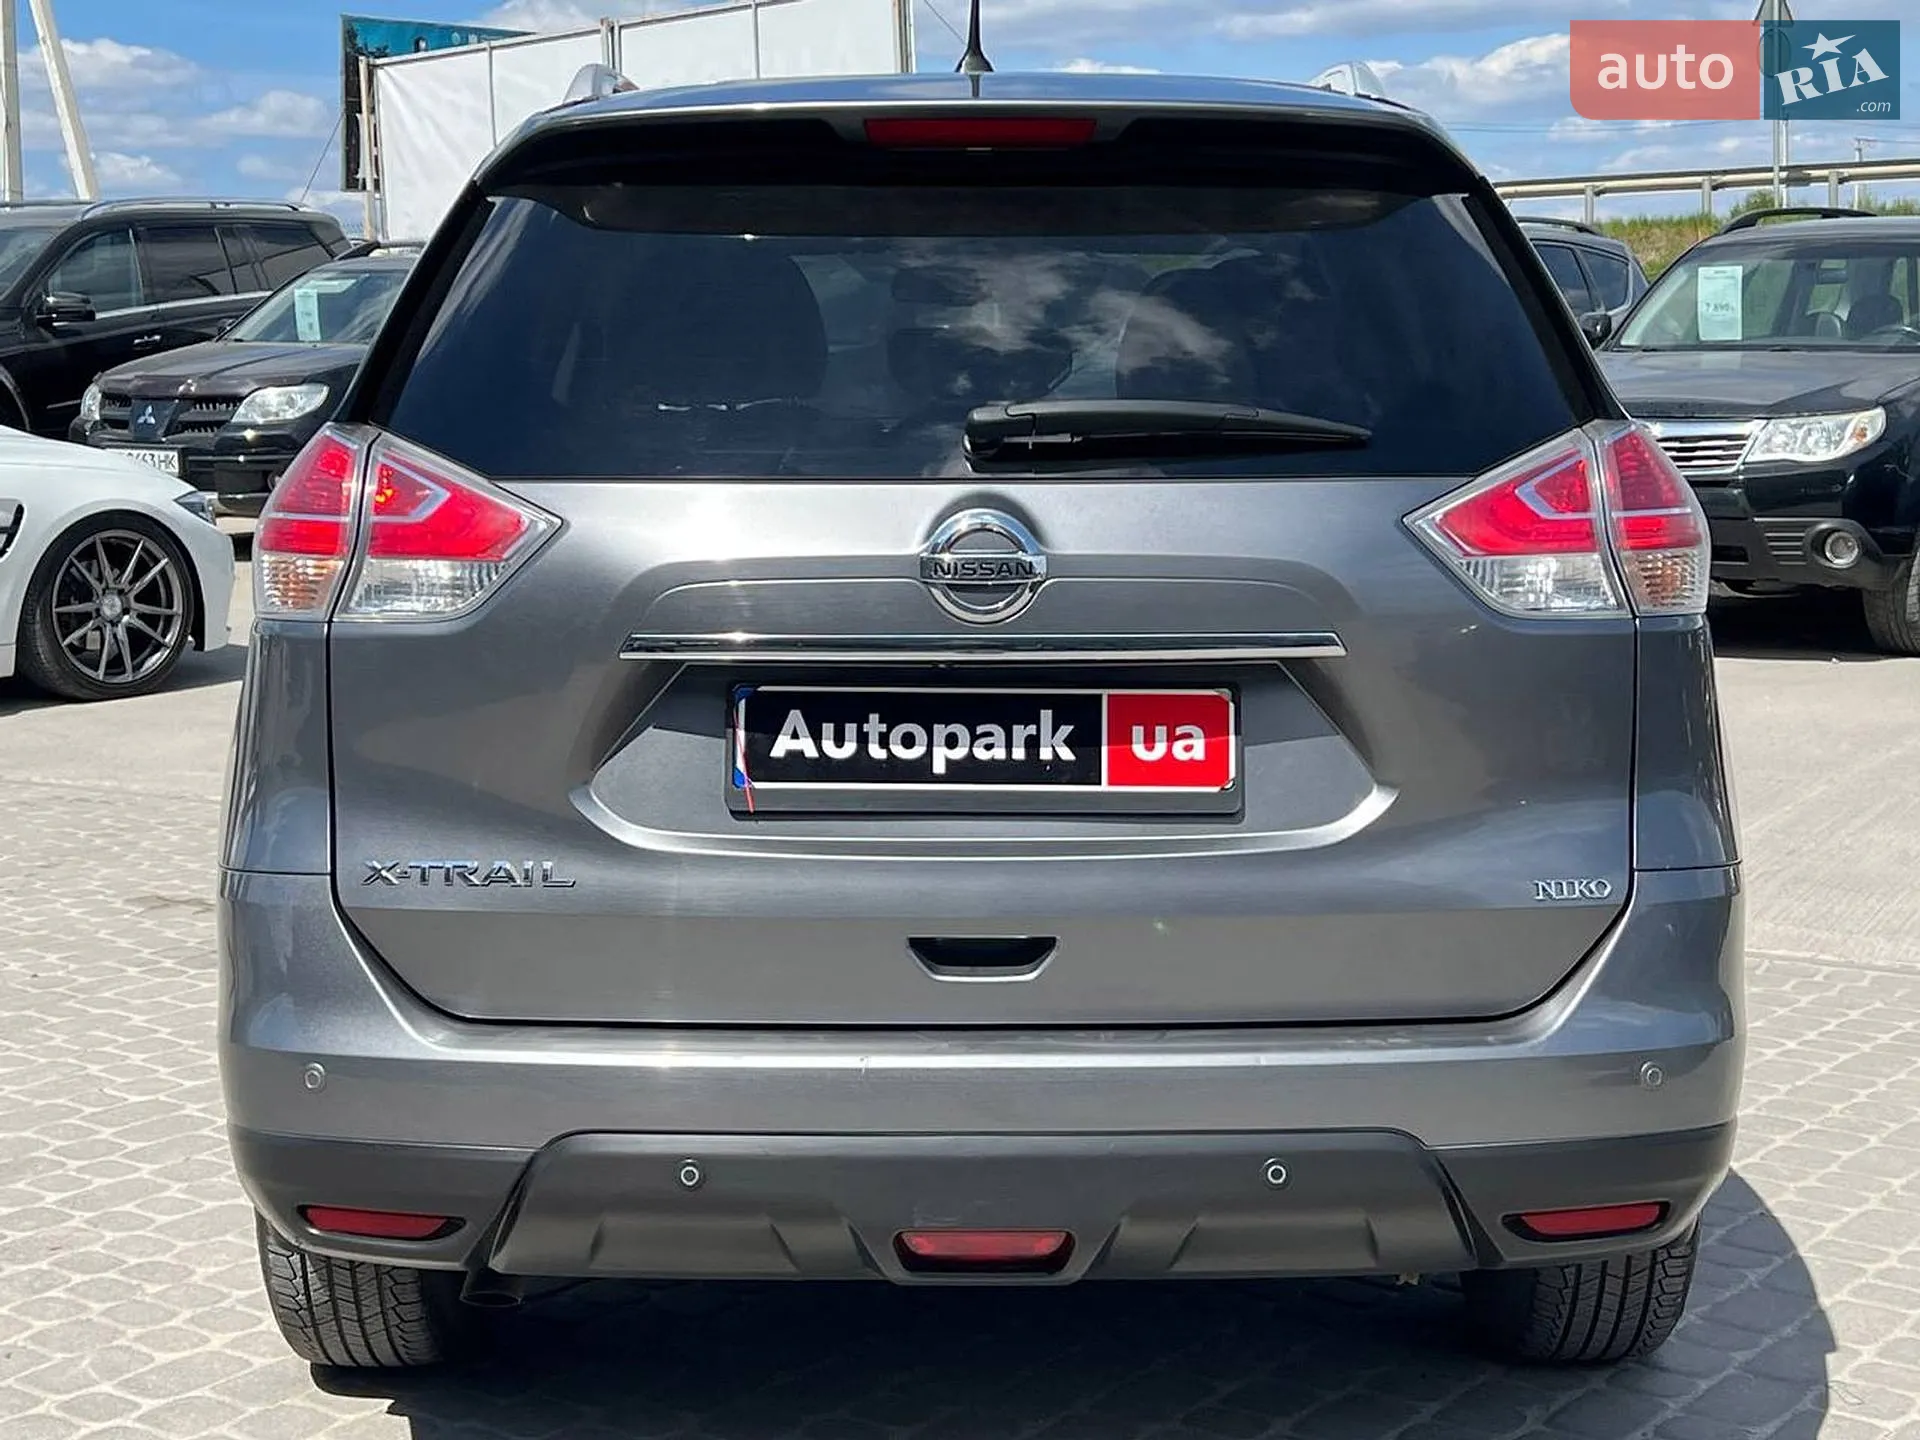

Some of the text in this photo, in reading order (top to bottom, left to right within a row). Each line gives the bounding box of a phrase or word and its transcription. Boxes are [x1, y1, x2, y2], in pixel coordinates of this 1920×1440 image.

[932, 561, 1034, 577] NISSAN
[769, 709, 1207, 774] Autopark ua
[361, 860, 576, 888] X-TRAIL
[1533, 879, 1612, 901] NIKO
